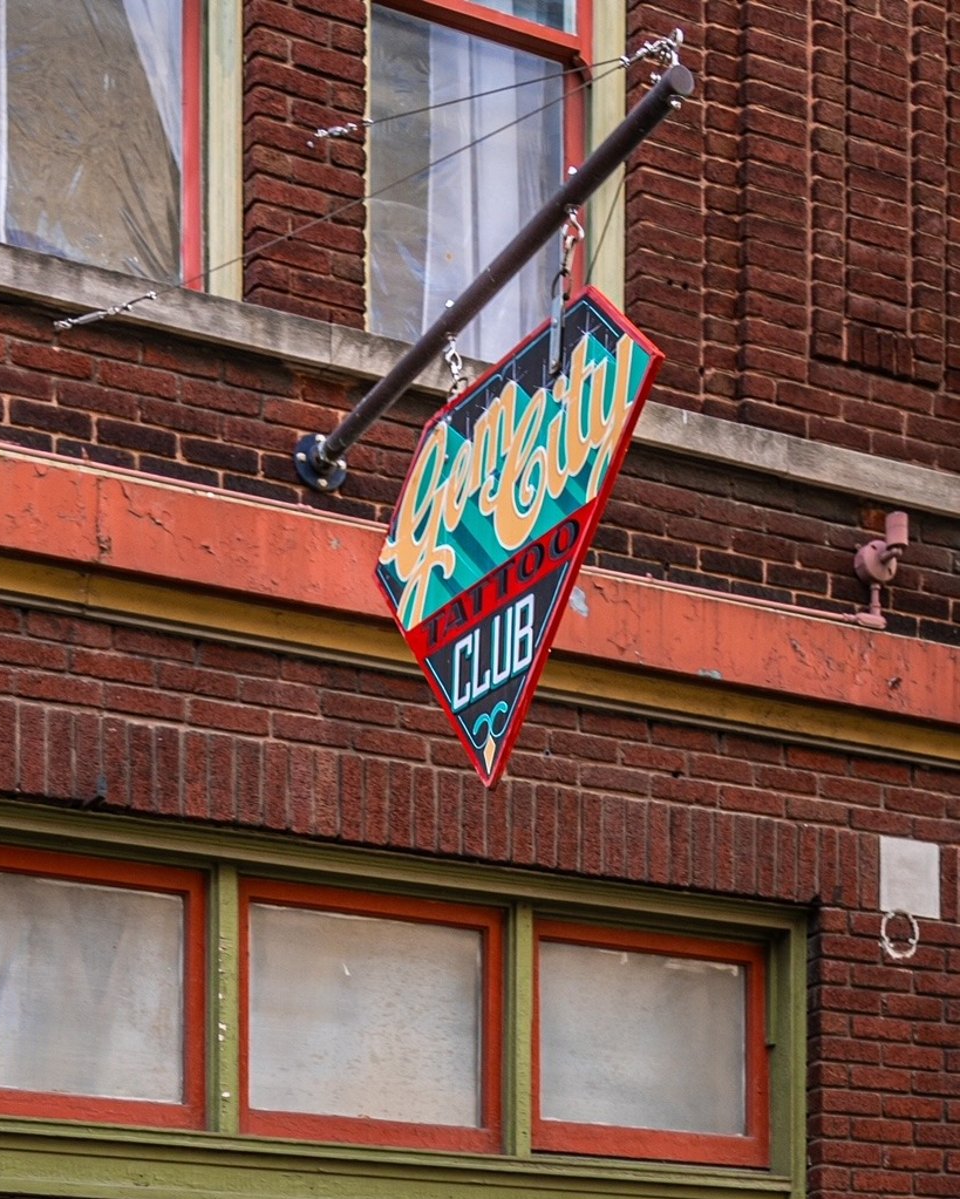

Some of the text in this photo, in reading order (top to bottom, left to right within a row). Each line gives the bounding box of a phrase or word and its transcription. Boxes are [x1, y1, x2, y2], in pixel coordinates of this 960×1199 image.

[379, 332, 634, 631] Gem City
[421, 519, 580, 650] TATTOO
[451, 593, 536, 713] CLUB
